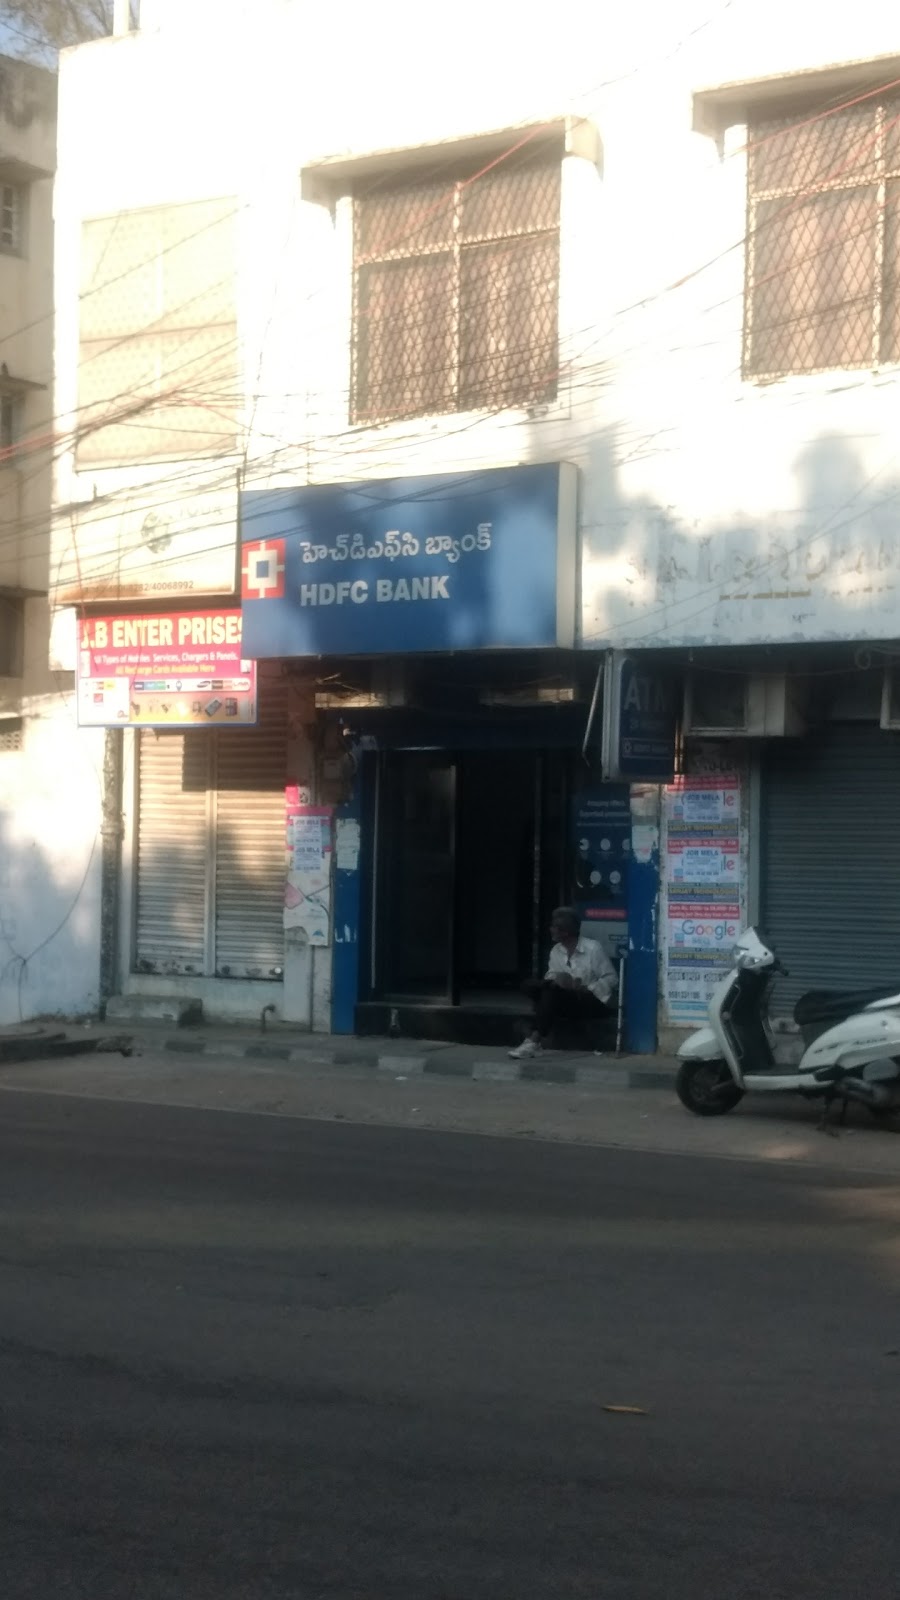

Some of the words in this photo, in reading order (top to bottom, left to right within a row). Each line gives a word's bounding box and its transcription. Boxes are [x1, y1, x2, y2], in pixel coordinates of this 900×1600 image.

[300, 580, 369, 606] HDFC
[376, 575, 450, 602] BANK
[112, 618, 174, 648] ENTER
[681, 919, 736, 940] Google
